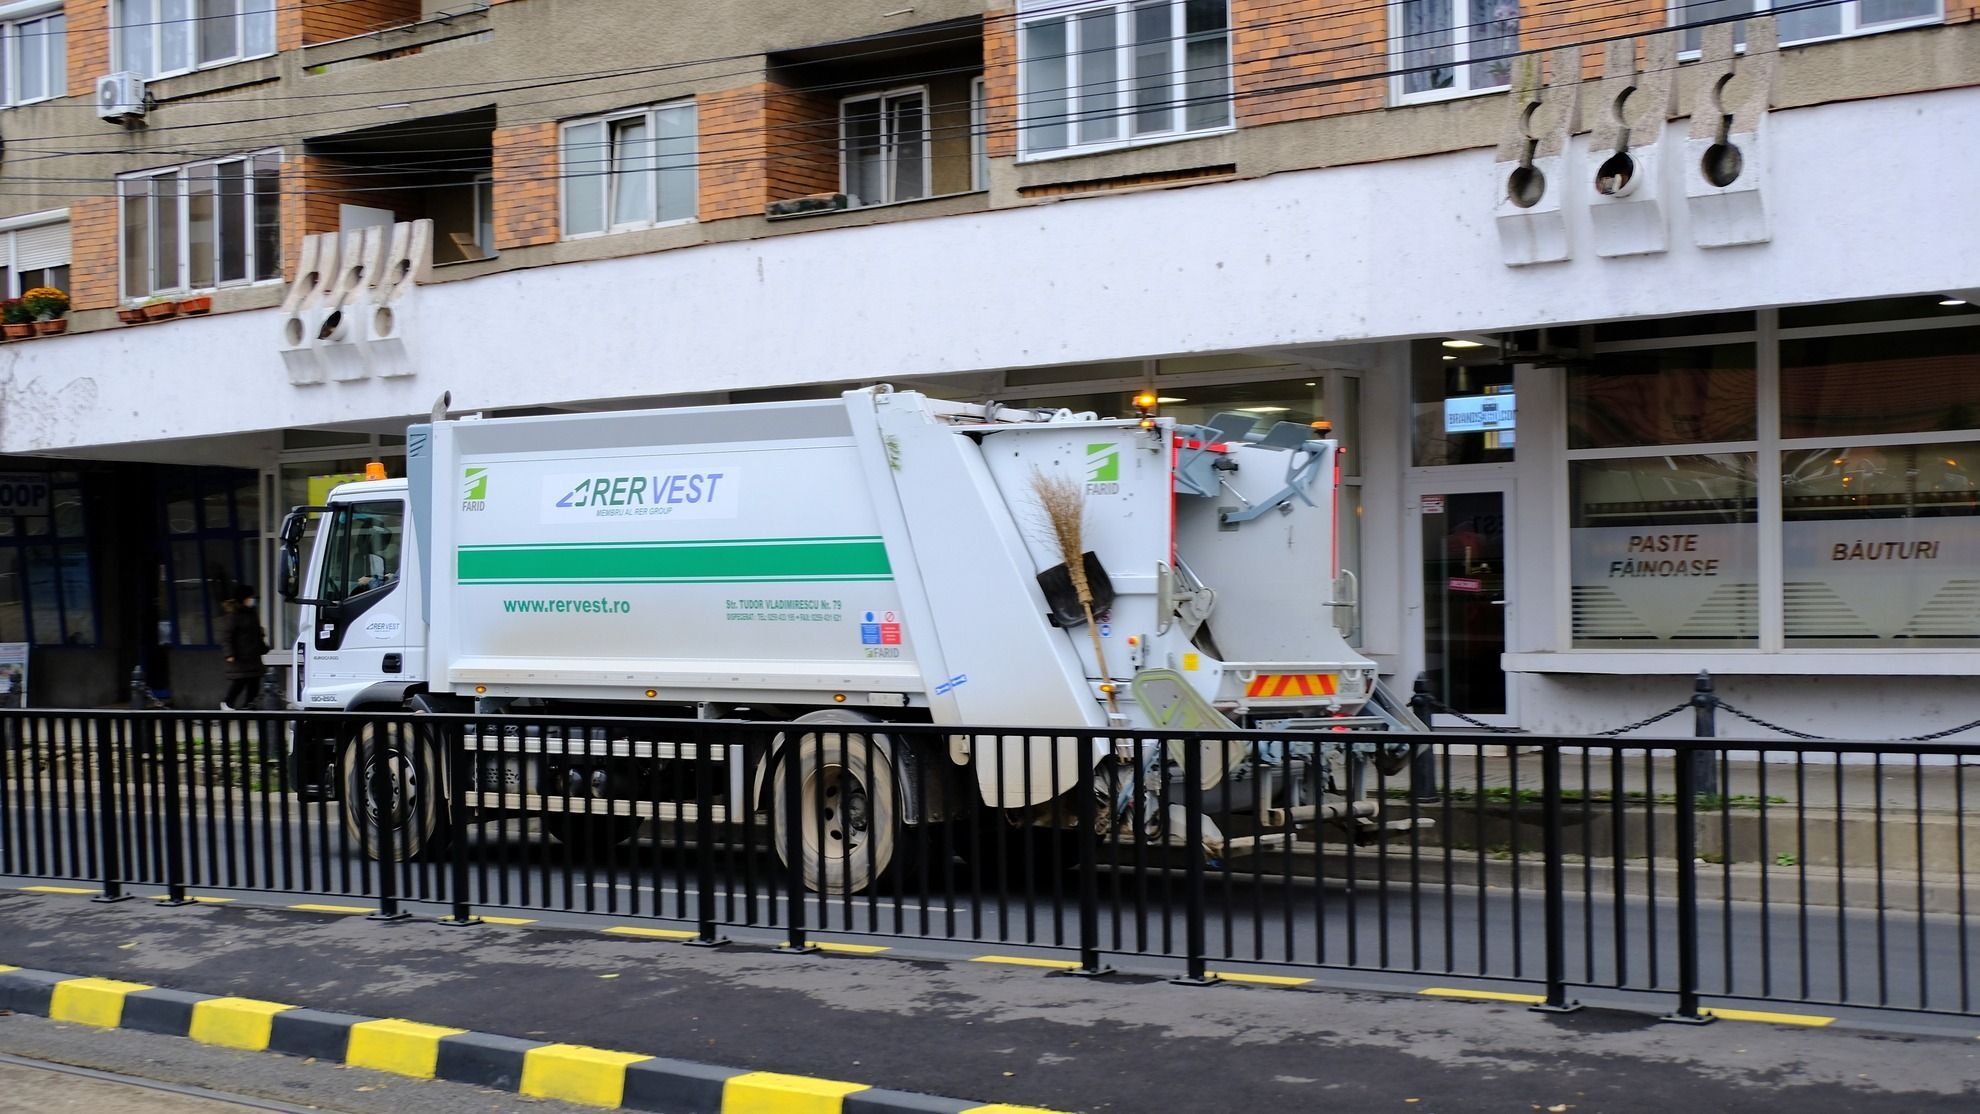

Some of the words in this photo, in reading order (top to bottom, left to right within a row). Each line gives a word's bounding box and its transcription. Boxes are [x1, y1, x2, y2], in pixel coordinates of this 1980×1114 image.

[591, 476, 647, 507] RER
[652, 473, 724, 505] VEST
[1086, 482, 1120, 496] FARID
[462, 500, 486, 512] FARID
[625, 508, 633, 516] AL
[649, 506, 673, 515] GROUP
[1627, 534, 1699, 553] PASTE
[1832, 539, 1941, 561] BĂUTURI
[1608, 558, 1720, 578] FĂINOASE
[504, 597, 631, 614] www.rervest.ro
[739, 599, 764, 610] TUDOR
[765, 599, 819, 610] VLADIMIRESCU
[873, 648, 900, 658] FARID
